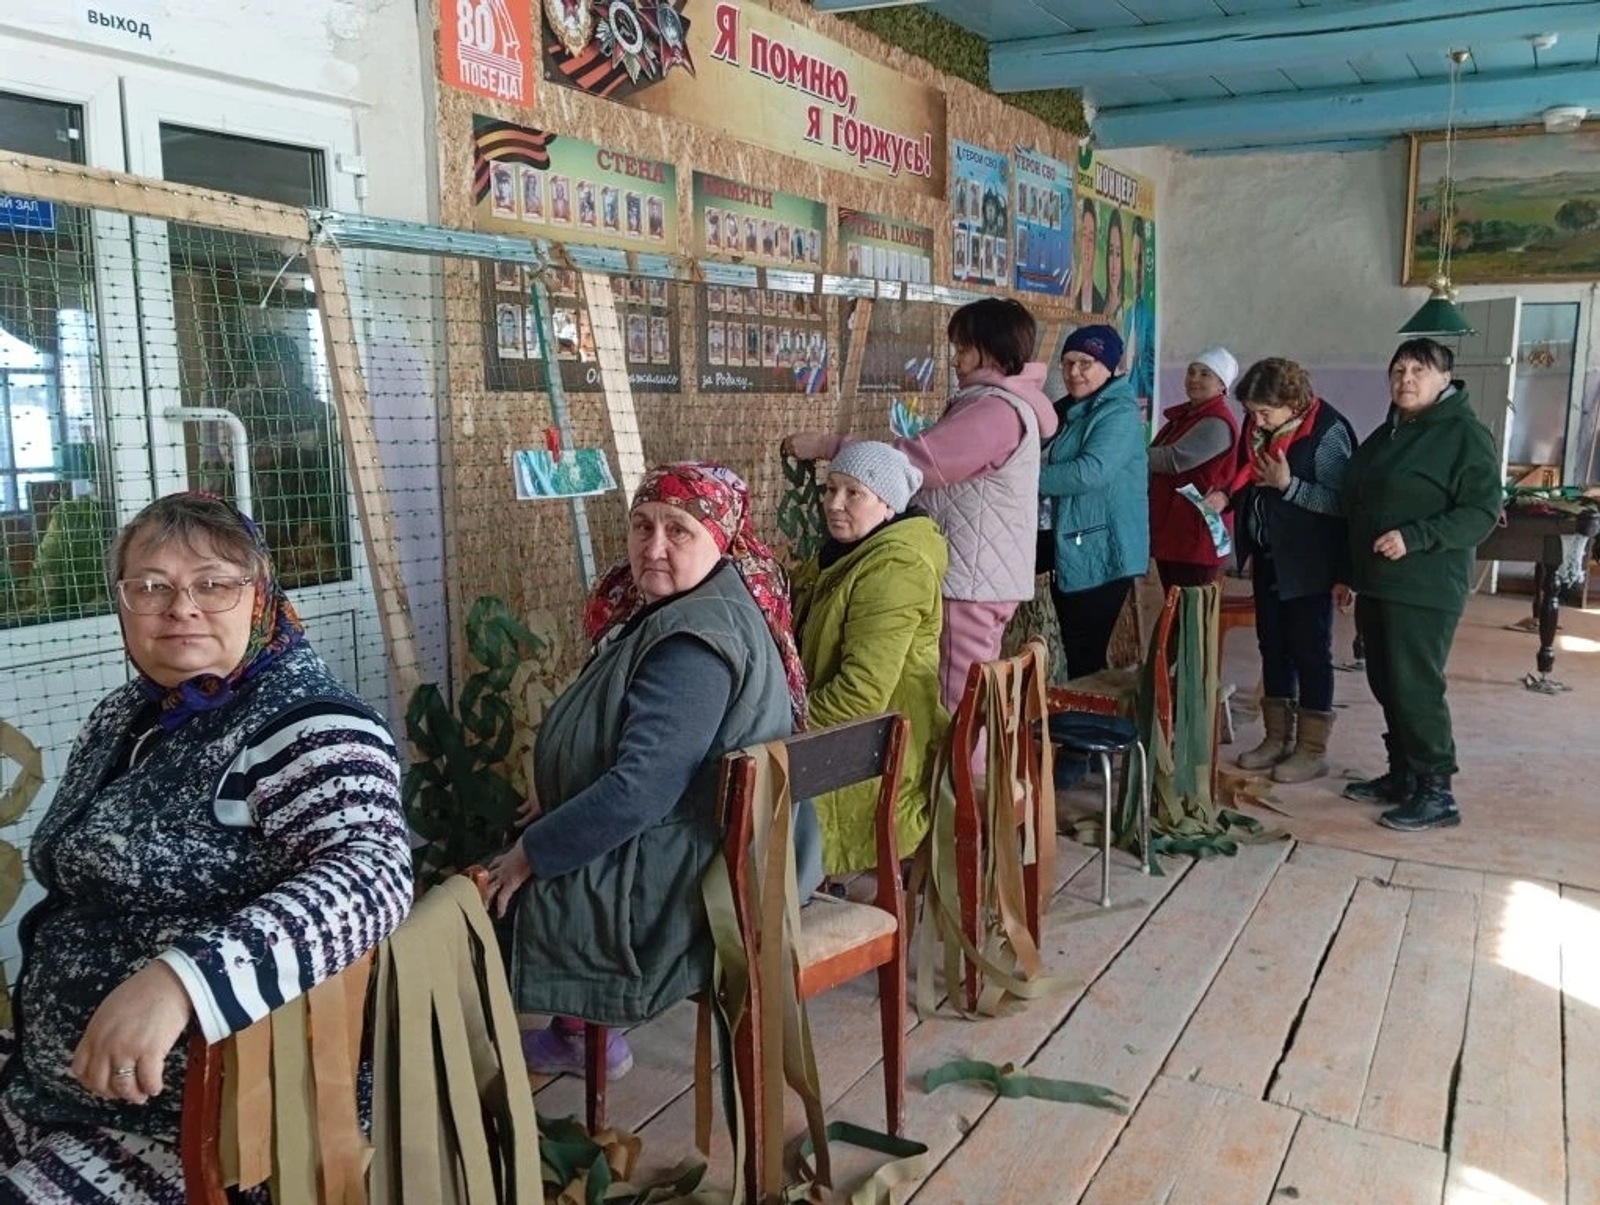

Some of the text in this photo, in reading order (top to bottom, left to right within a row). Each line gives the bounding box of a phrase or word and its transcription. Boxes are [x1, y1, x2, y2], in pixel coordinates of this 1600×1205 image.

[87, 9, 152, 41] ВЫХОД
[457, 0, 495, 53] 80
[712, 3, 857, 117] Я помню,
[460, 61, 524, 101] ПОБЕДА!
[832, 111, 931, 177] горжусь!
[596, 149, 666, 184] СТЕНА
[1096, 162, 1138, 209] КОНЦЕРТ
[15, 199, 39, 211] ЗАЛ
[703, 175, 773, 209] ПАМЯТИ
